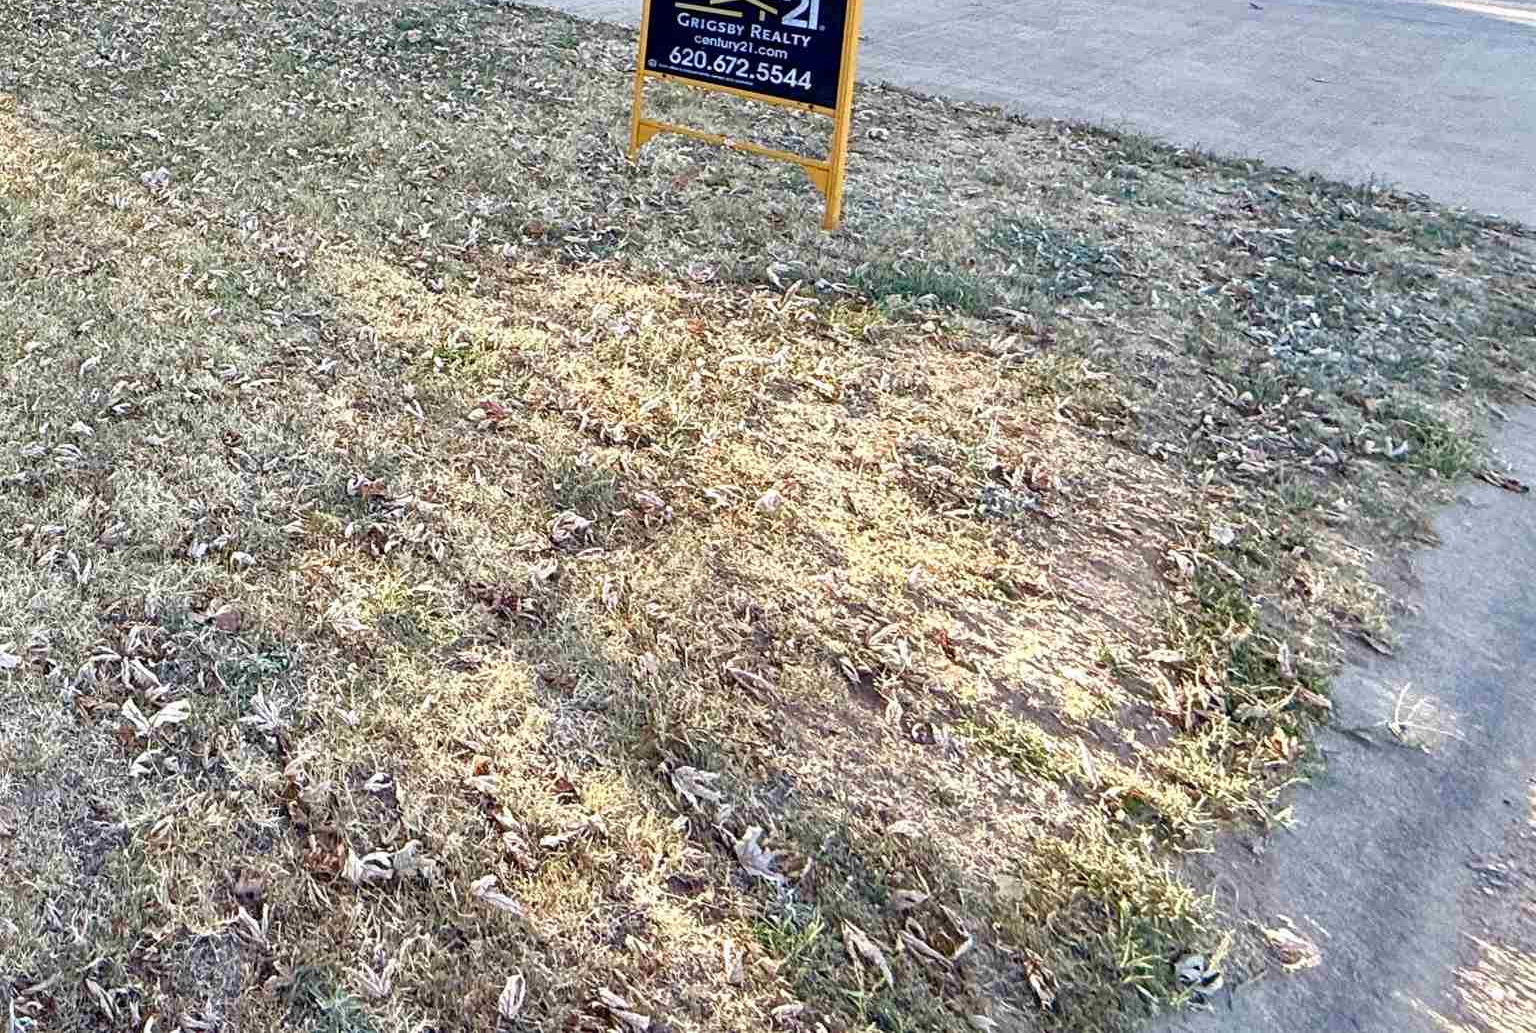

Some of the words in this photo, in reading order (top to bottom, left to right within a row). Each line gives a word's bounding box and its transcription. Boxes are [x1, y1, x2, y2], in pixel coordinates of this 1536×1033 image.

[676, 12, 745, 36] GRIGSBY
[750, 24, 812, 47] REALTY
[693, 34, 788, 60] century21.com
[668, 46, 813, 91] 620.672.5544
